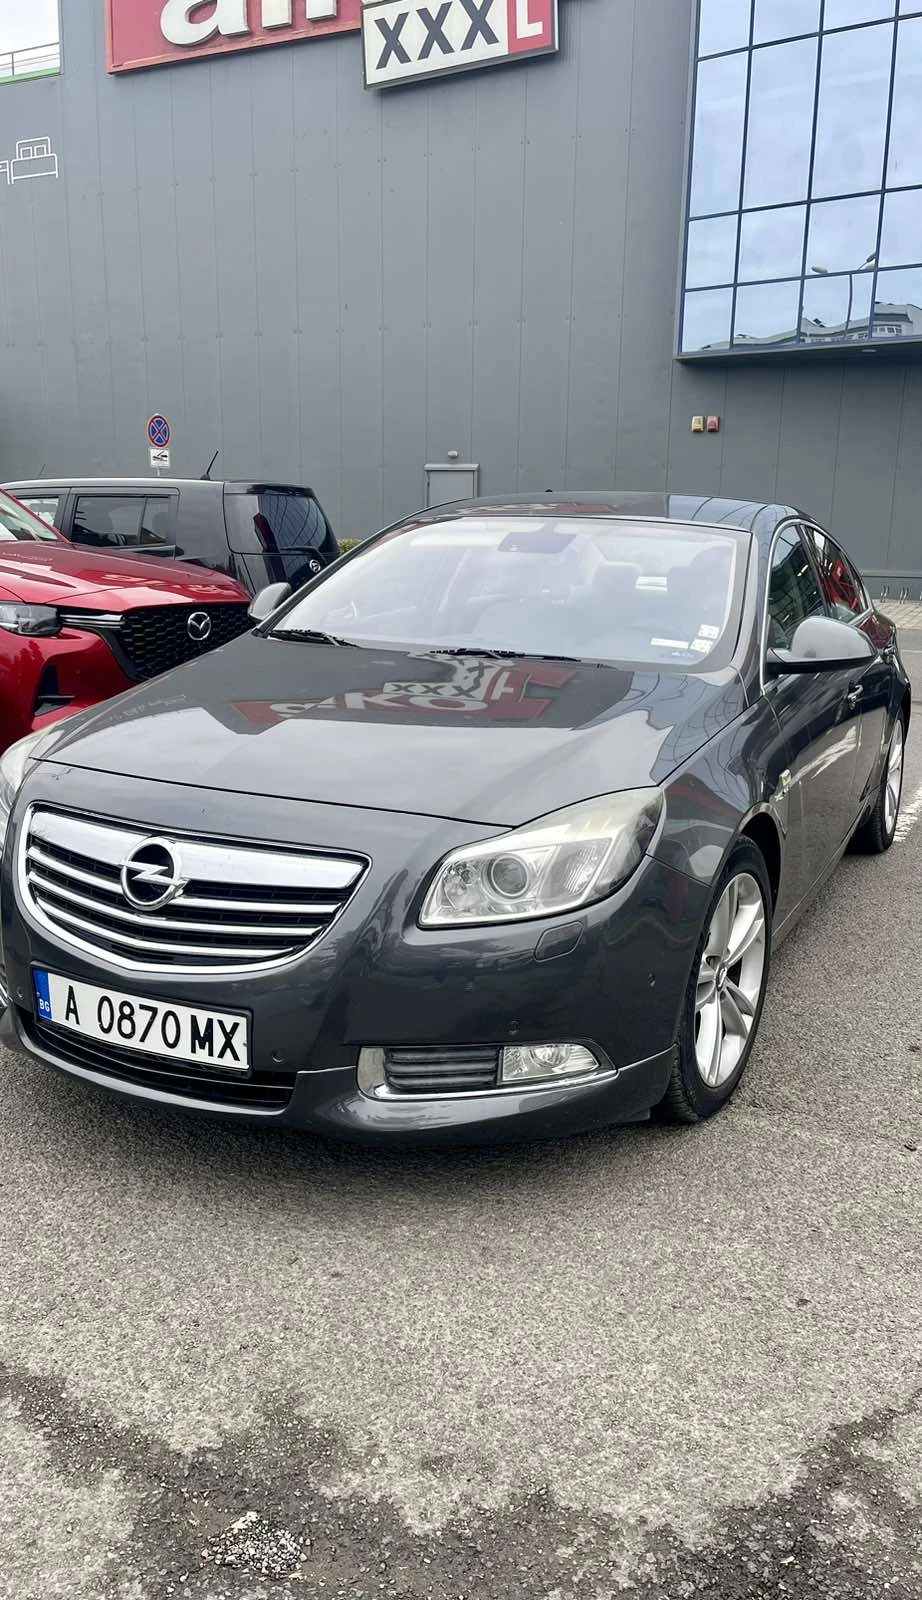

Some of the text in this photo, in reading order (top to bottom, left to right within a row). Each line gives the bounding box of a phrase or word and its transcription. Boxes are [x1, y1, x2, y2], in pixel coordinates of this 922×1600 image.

[374, 0, 544, 70] XXXL
[39, 998, 50, 1012] BG
[65, 985, 241, 1062] A 0870 MX
